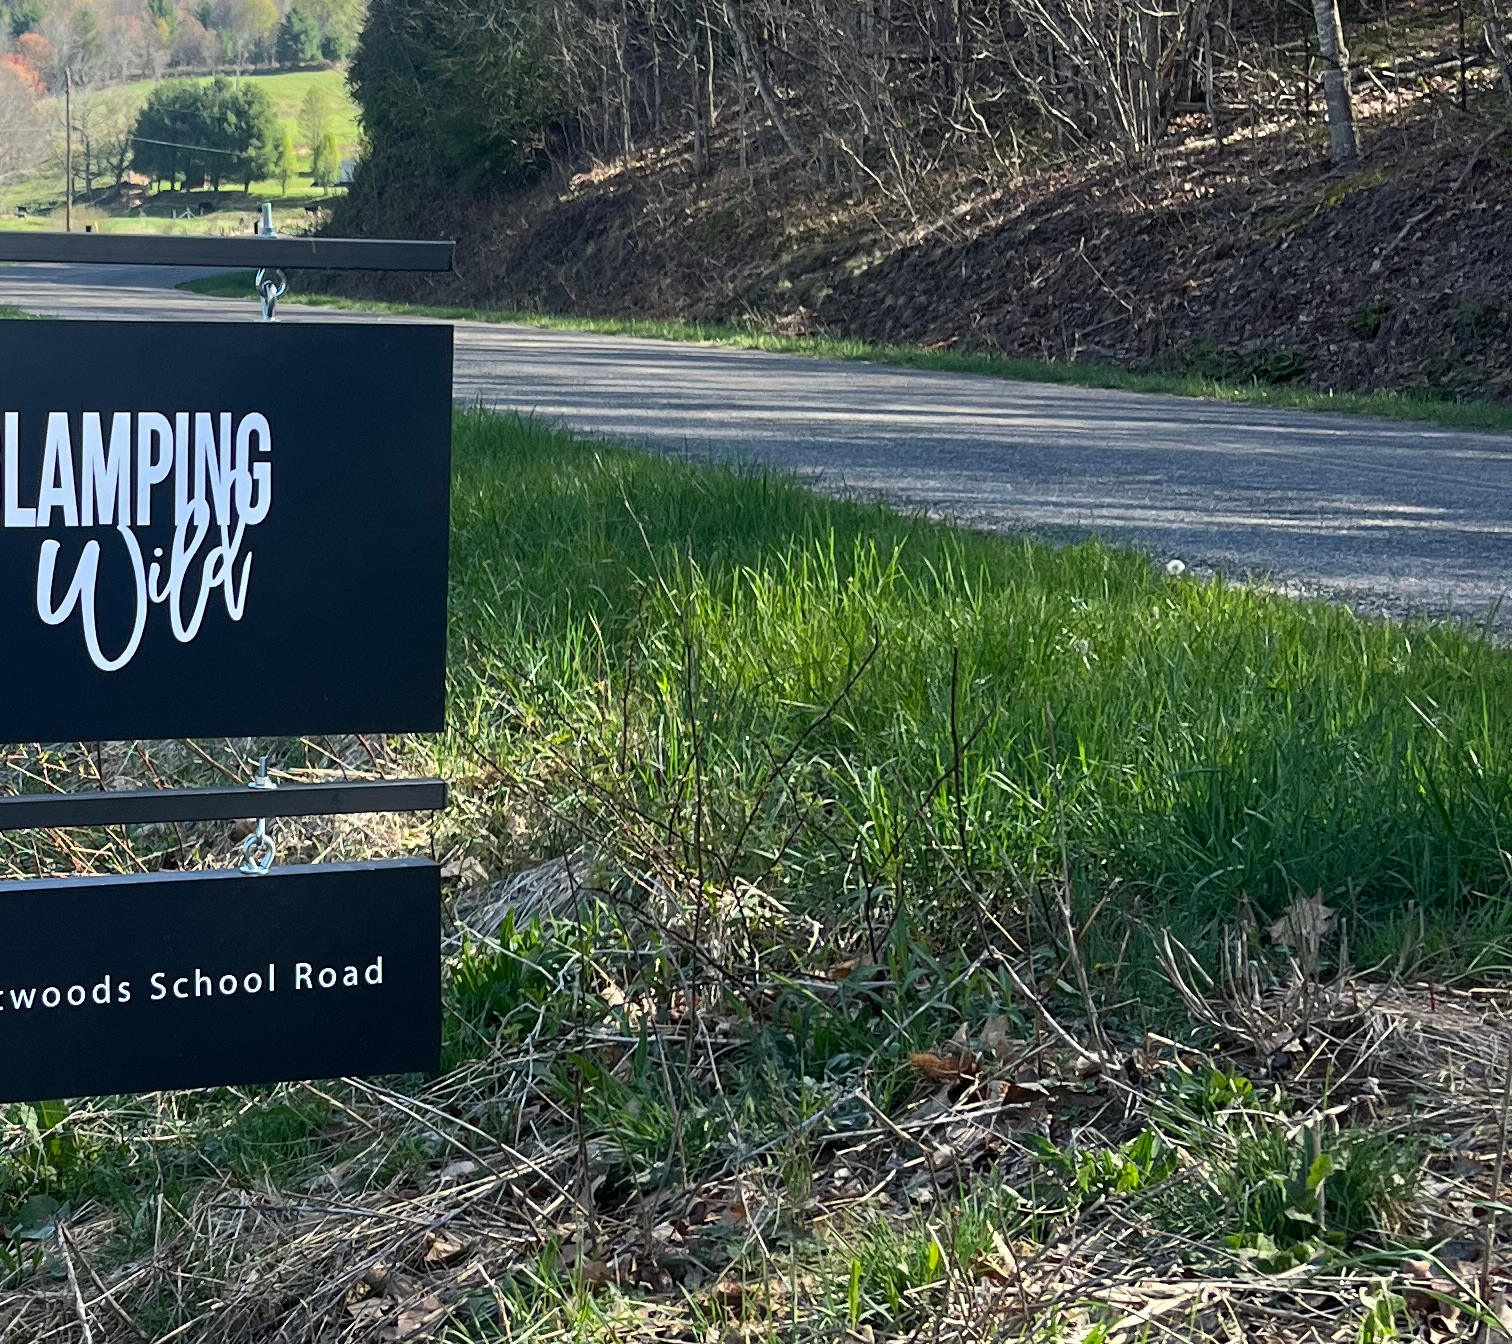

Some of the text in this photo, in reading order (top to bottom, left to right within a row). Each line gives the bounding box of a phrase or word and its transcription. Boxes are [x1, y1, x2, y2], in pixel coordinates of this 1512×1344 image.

[36, 469, 253, 672] Wild
[150, 963, 276, 1000] School
[295, 955, 384, 990] Road
